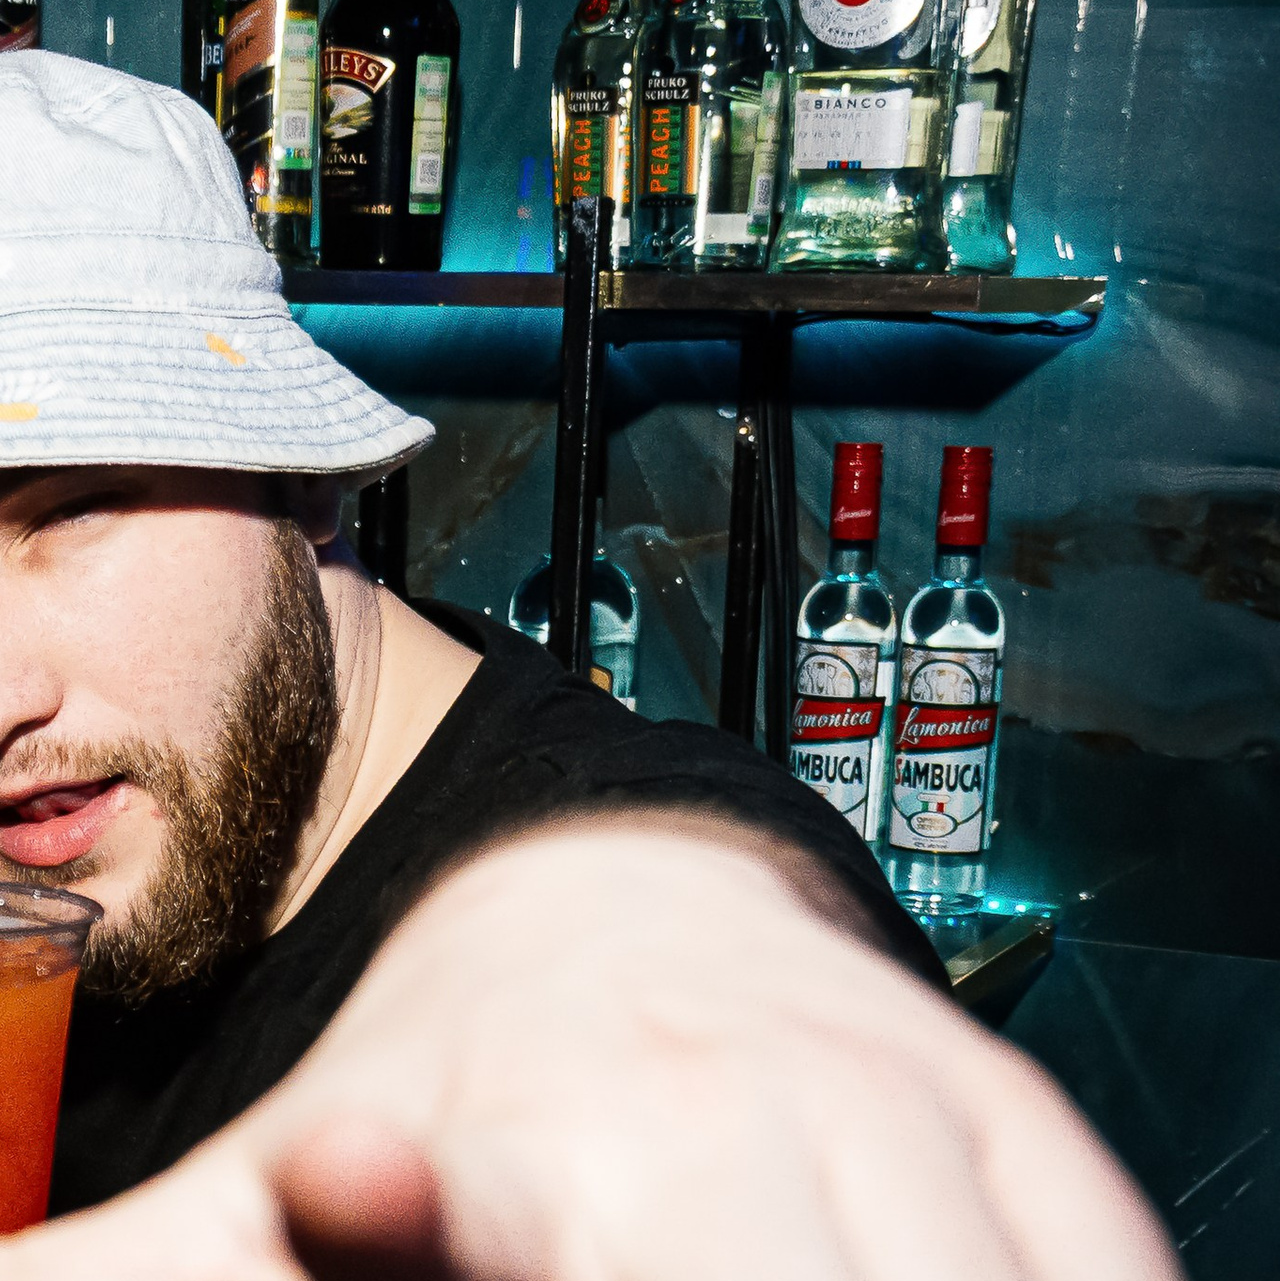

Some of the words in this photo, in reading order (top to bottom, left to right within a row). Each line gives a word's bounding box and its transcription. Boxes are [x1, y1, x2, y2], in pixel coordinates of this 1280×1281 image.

[324, 53, 383, 81] ILEYS
[568, 100, 610, 113] SCHULZ
[645, 88, 690, 101] SCHULZ
[814, 97, 887, 110] BIANCO
[573, 119, 592, 197] PEACH
[650, 108, 671, 194] PEACH
[896, 706, 991, 745] Lamonica
[894, 758, 982, 793] SAMBUCA
